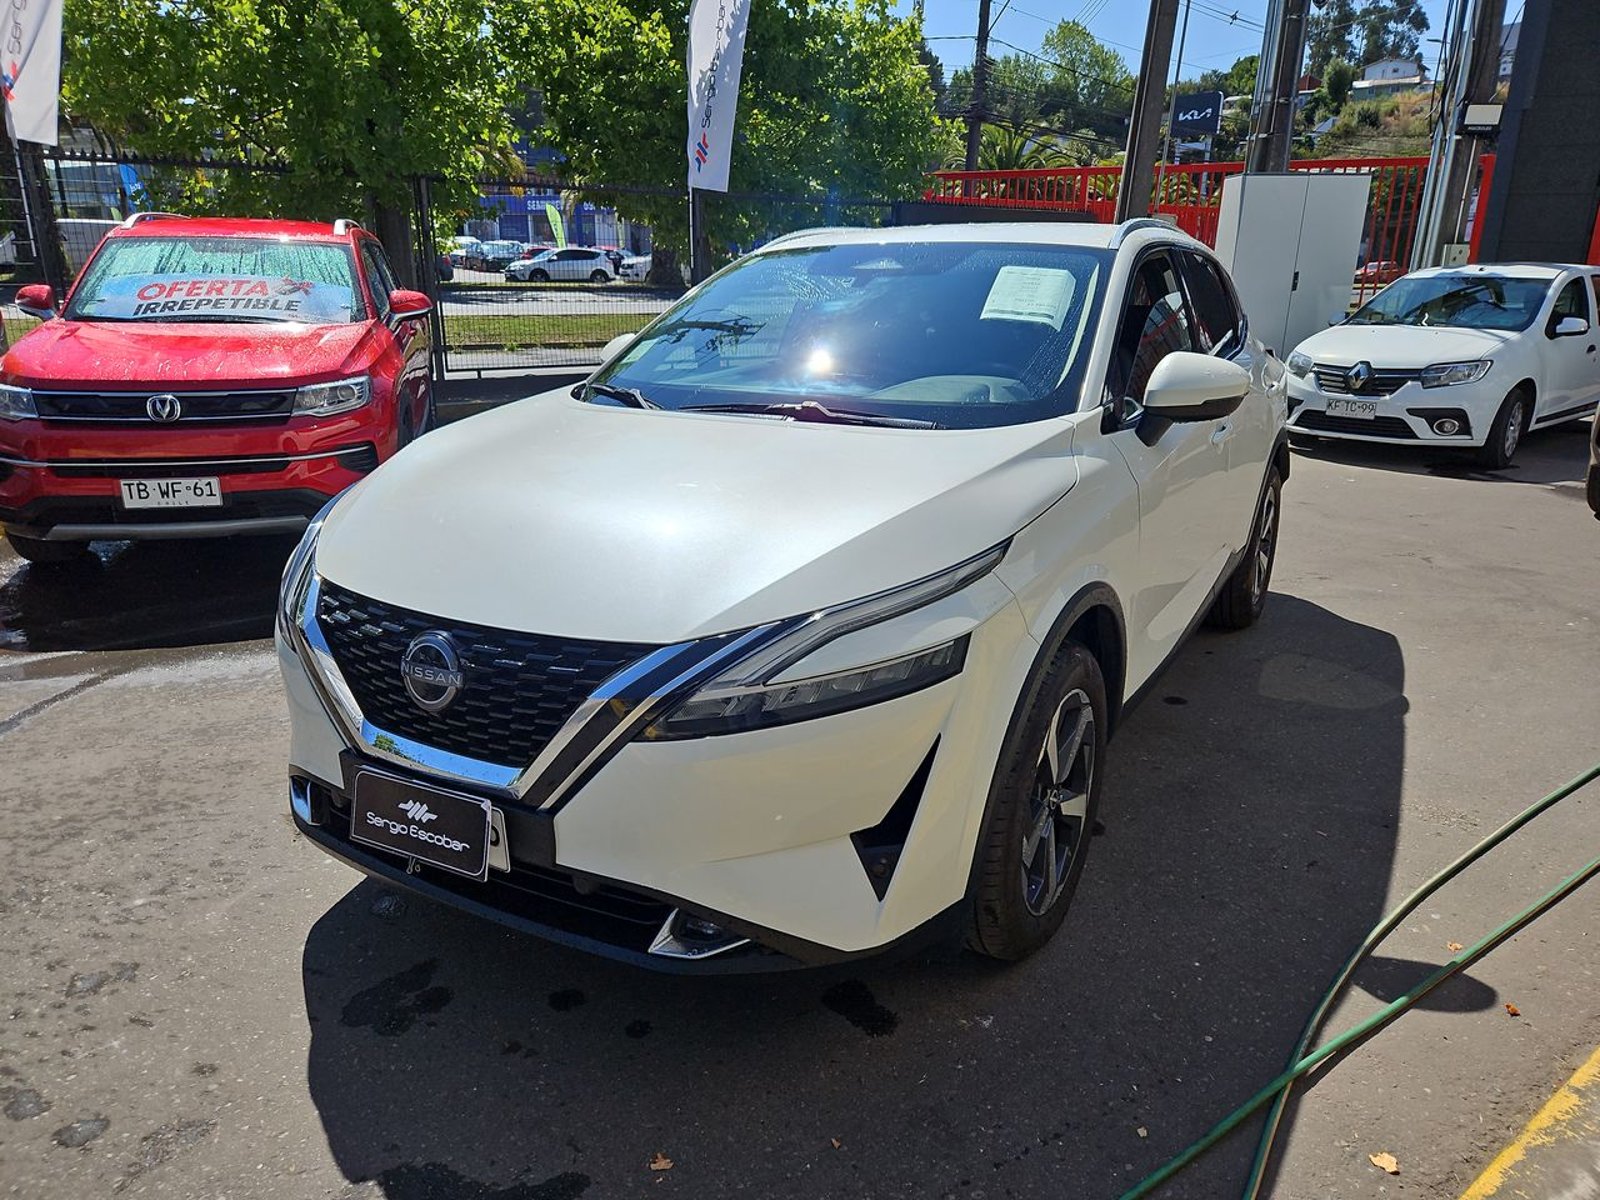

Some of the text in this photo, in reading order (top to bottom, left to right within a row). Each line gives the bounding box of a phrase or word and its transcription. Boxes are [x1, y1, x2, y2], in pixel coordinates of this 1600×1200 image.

[1178, 108, 1212, 121] KIA
[137, 280, 269, 300] OFERTA
[133, 298, 301, 316] IRREPETIBLE
[401, 661, 461, 685] NISSAN
[366, 811, 408, 834] Sergo
[409, 825, 470, 852] Escobar
